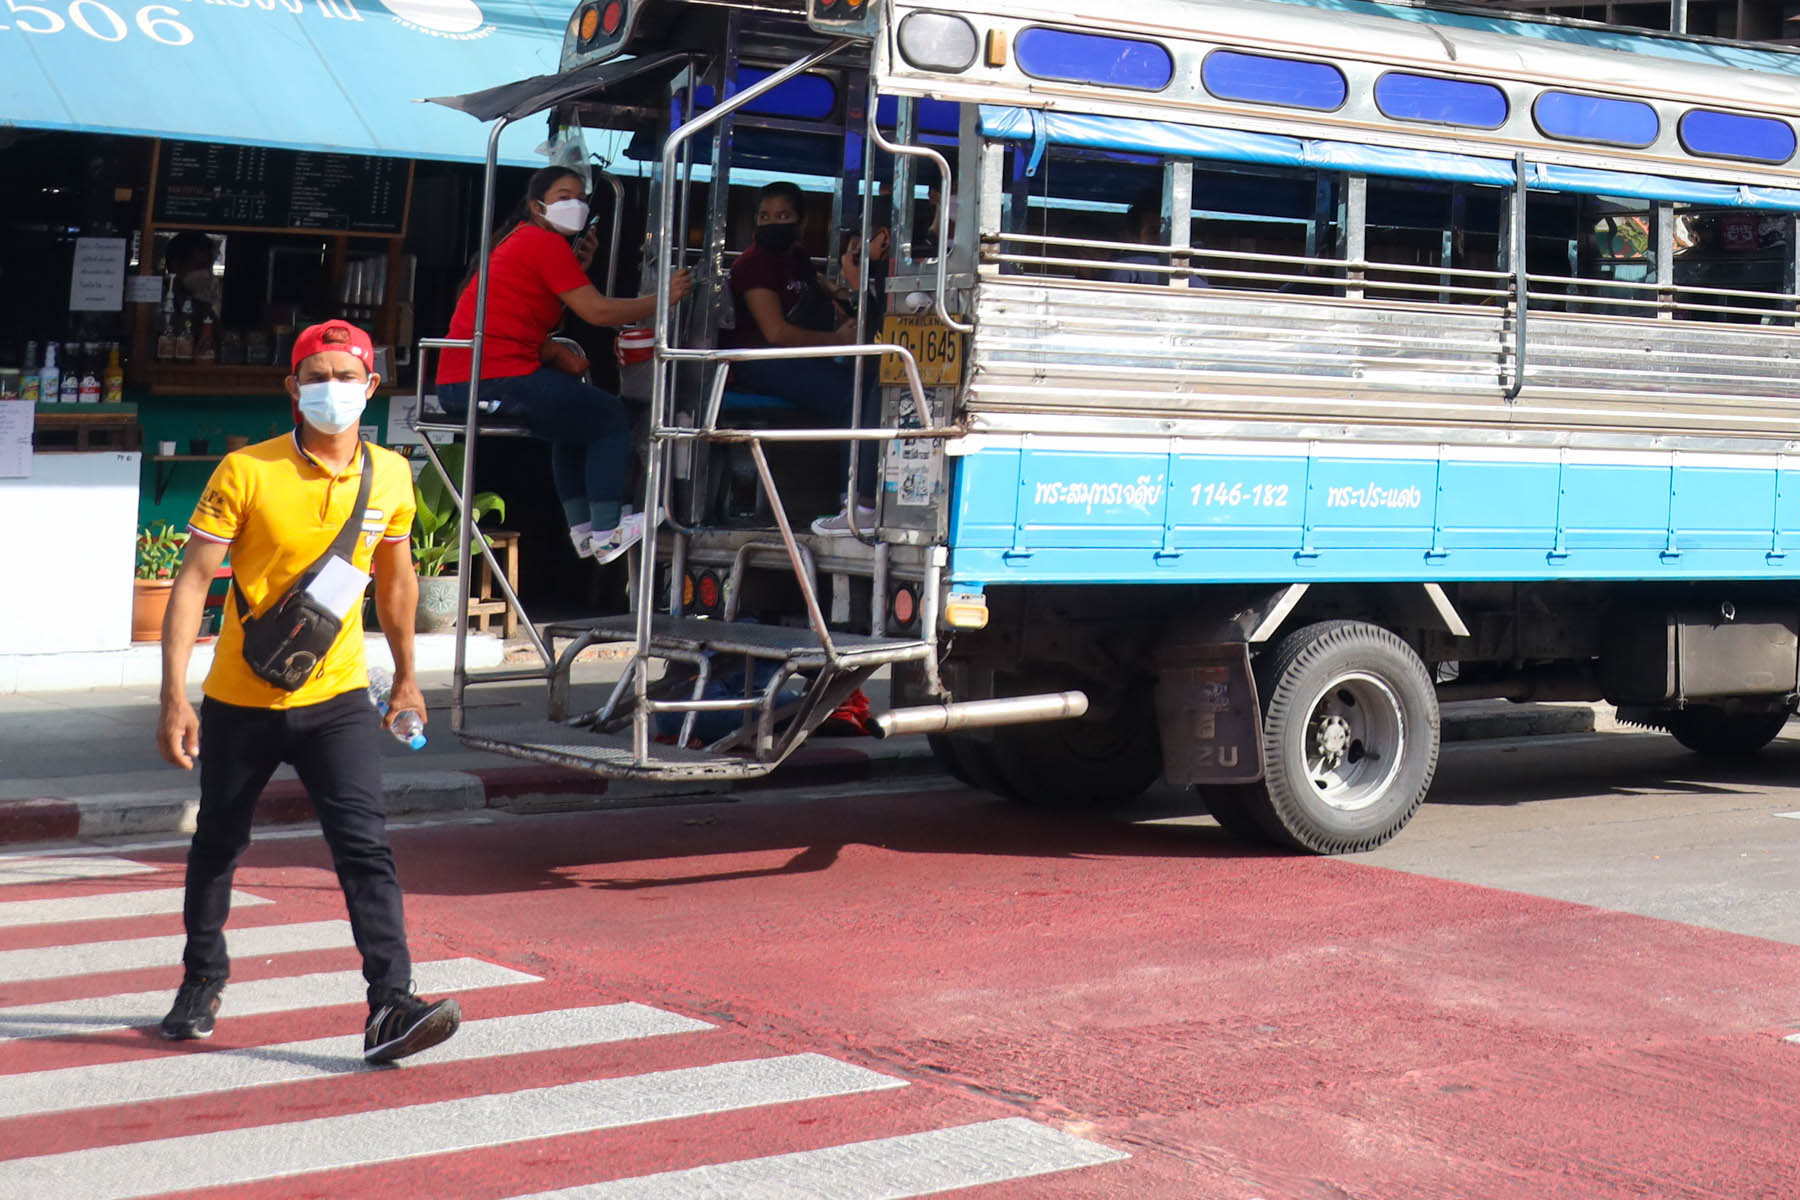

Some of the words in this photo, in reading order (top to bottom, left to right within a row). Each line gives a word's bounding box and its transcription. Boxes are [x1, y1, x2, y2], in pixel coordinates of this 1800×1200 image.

[1190, 481, 1290, 507] 1146-182
[1327, 481, 1422, 509] พระประแดง
